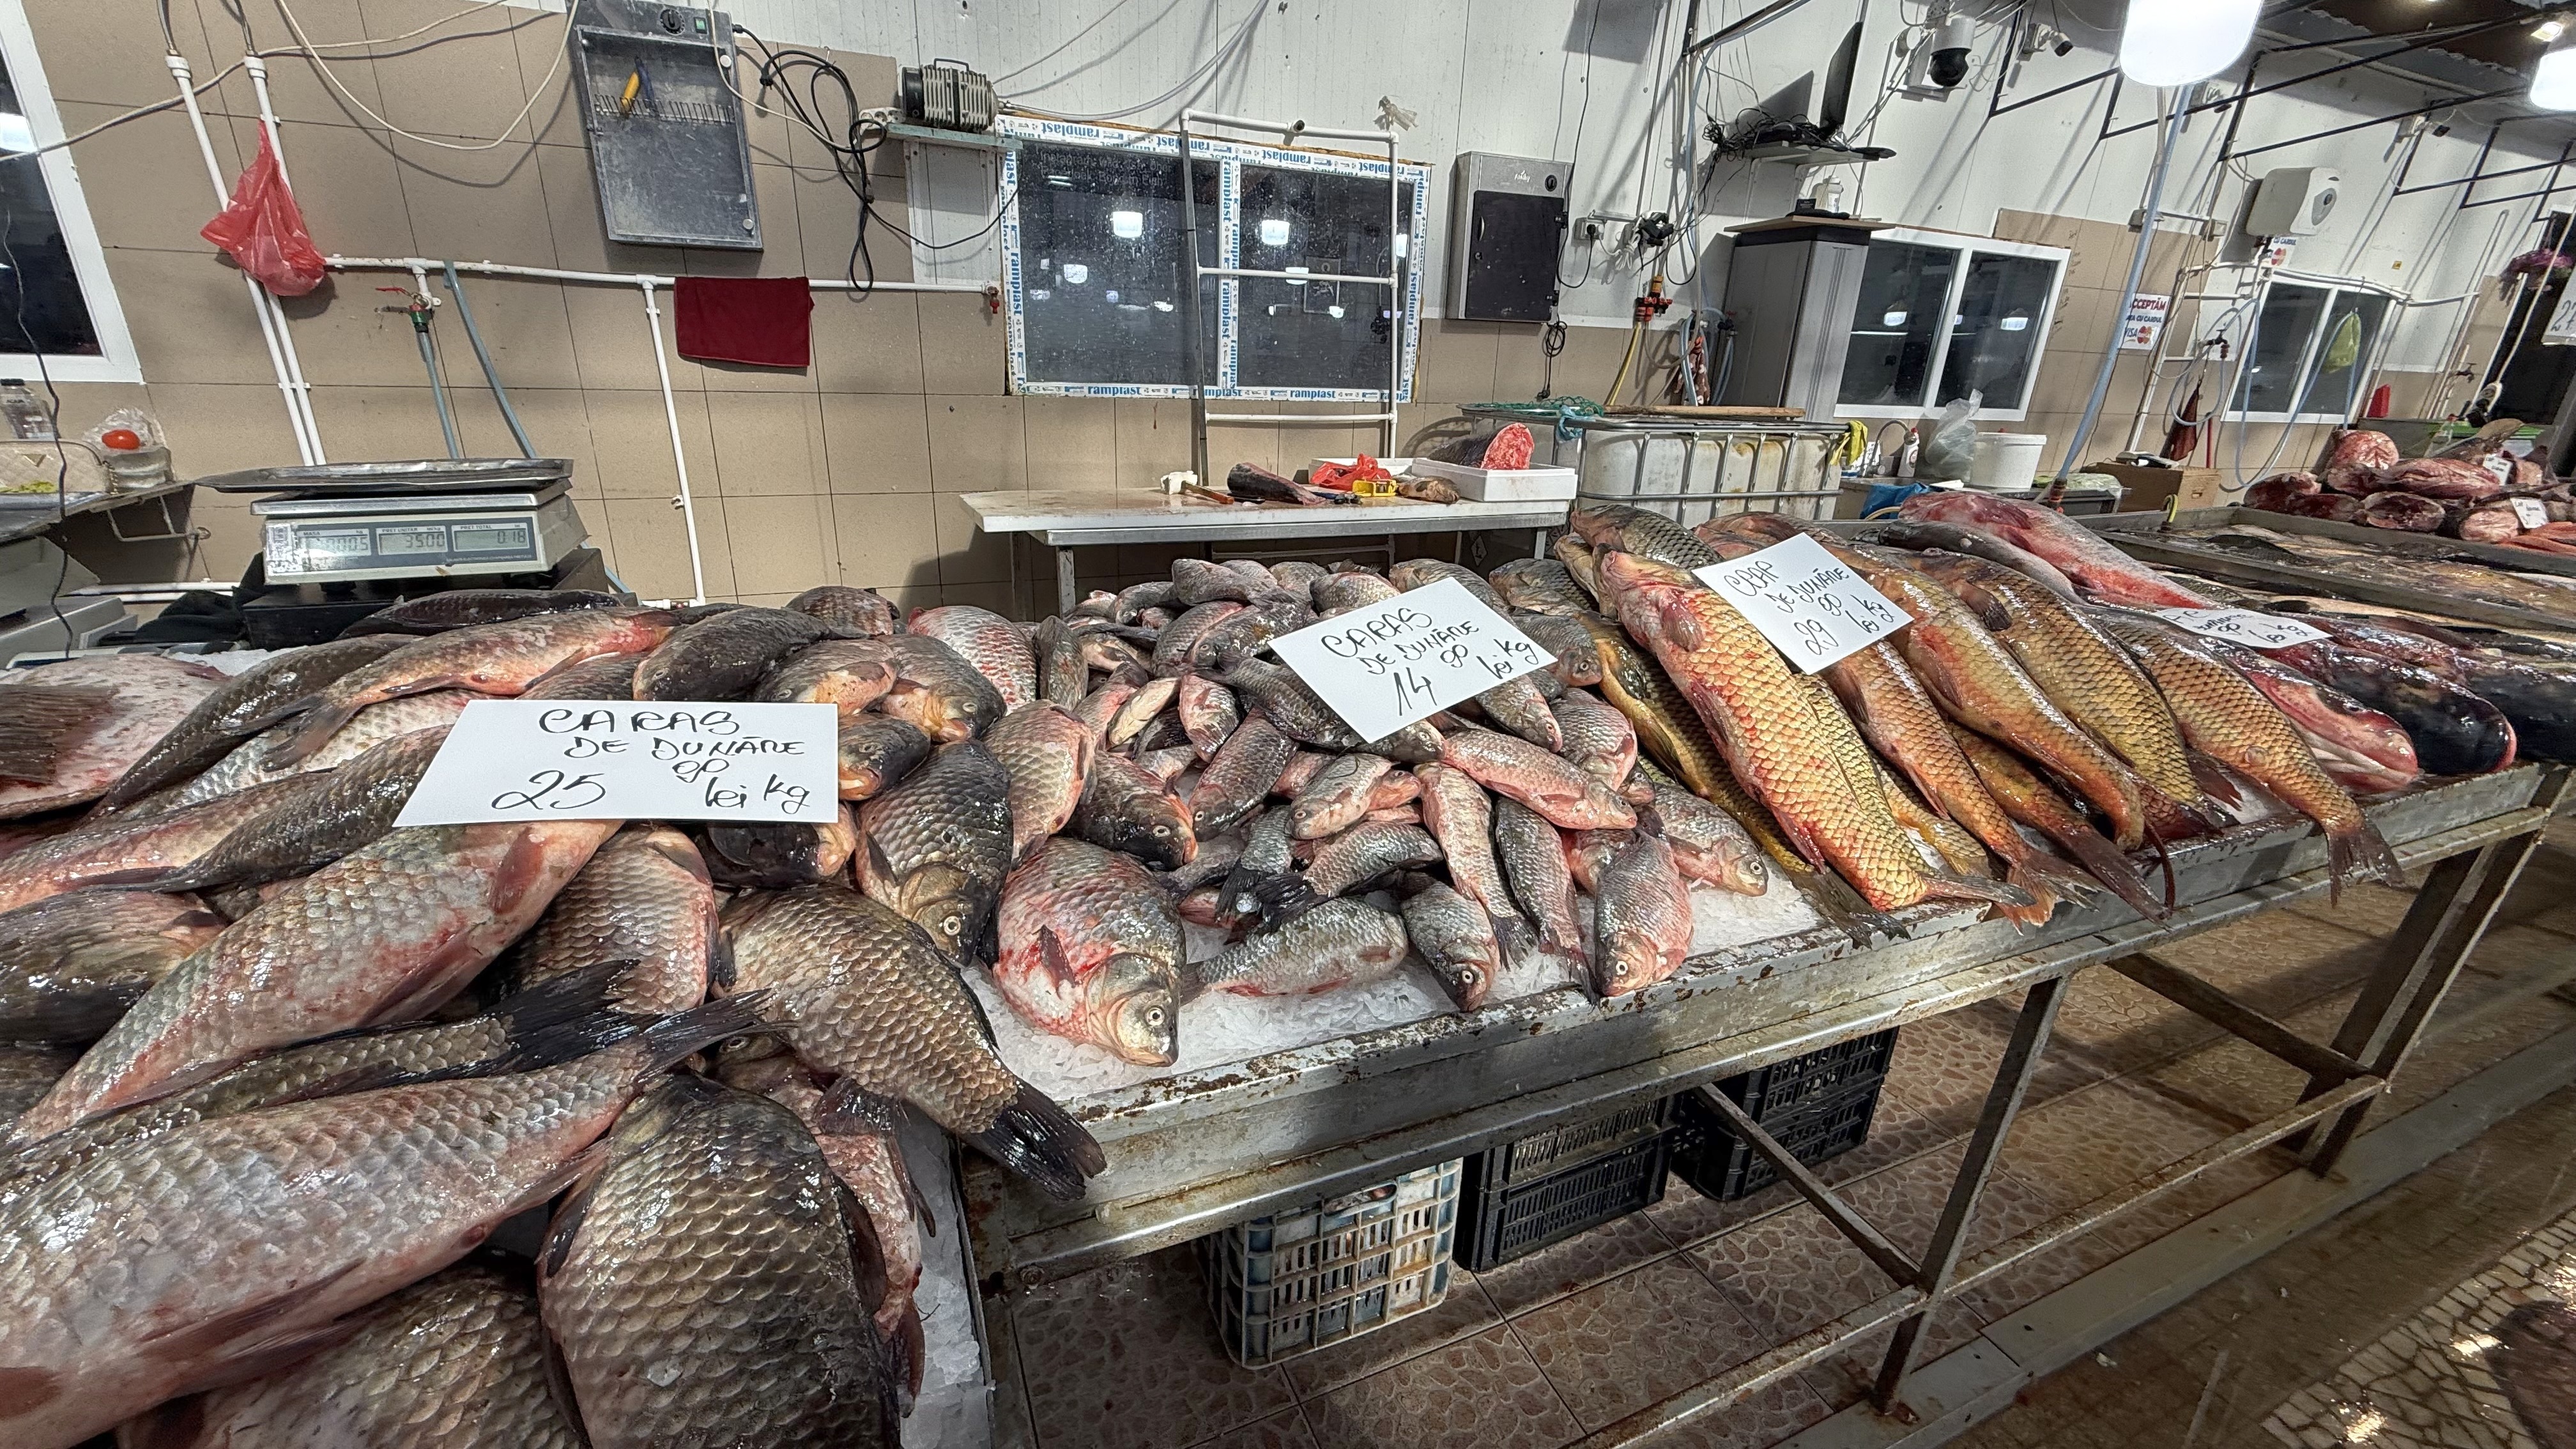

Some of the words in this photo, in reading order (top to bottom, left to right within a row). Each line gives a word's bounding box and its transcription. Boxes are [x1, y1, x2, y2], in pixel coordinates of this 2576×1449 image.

[1040, 122, 1100, 139] ramplast
[1262, 150, 1311, 164] ramplast
[1223, 159, 1232, 222] ramplast
[1011, 252, 1022, 316] ramplast
[1407, 272, 1418, 325] ramplast
[1222, 282, 1231, 340] ramplast
[1087, 385, 1142, 397] ramplast
[1290, 389, 1337, 399] ramplast
[1850, 594, 1896, 624] kg
[1321, 608, 1433, 658] CARAS
[1493, 639, 1539, 665] kg
[1355, 652, 1396, 675] DE
[1393, 667, 1438, 716] 14
[539, 708, 740, 735] CARAS
[564, 736, 630, 759] DE
[491, 769, 606, 810] 25
[703, 777, 747, 809] lei
[763, 774, 811, 815] kg
